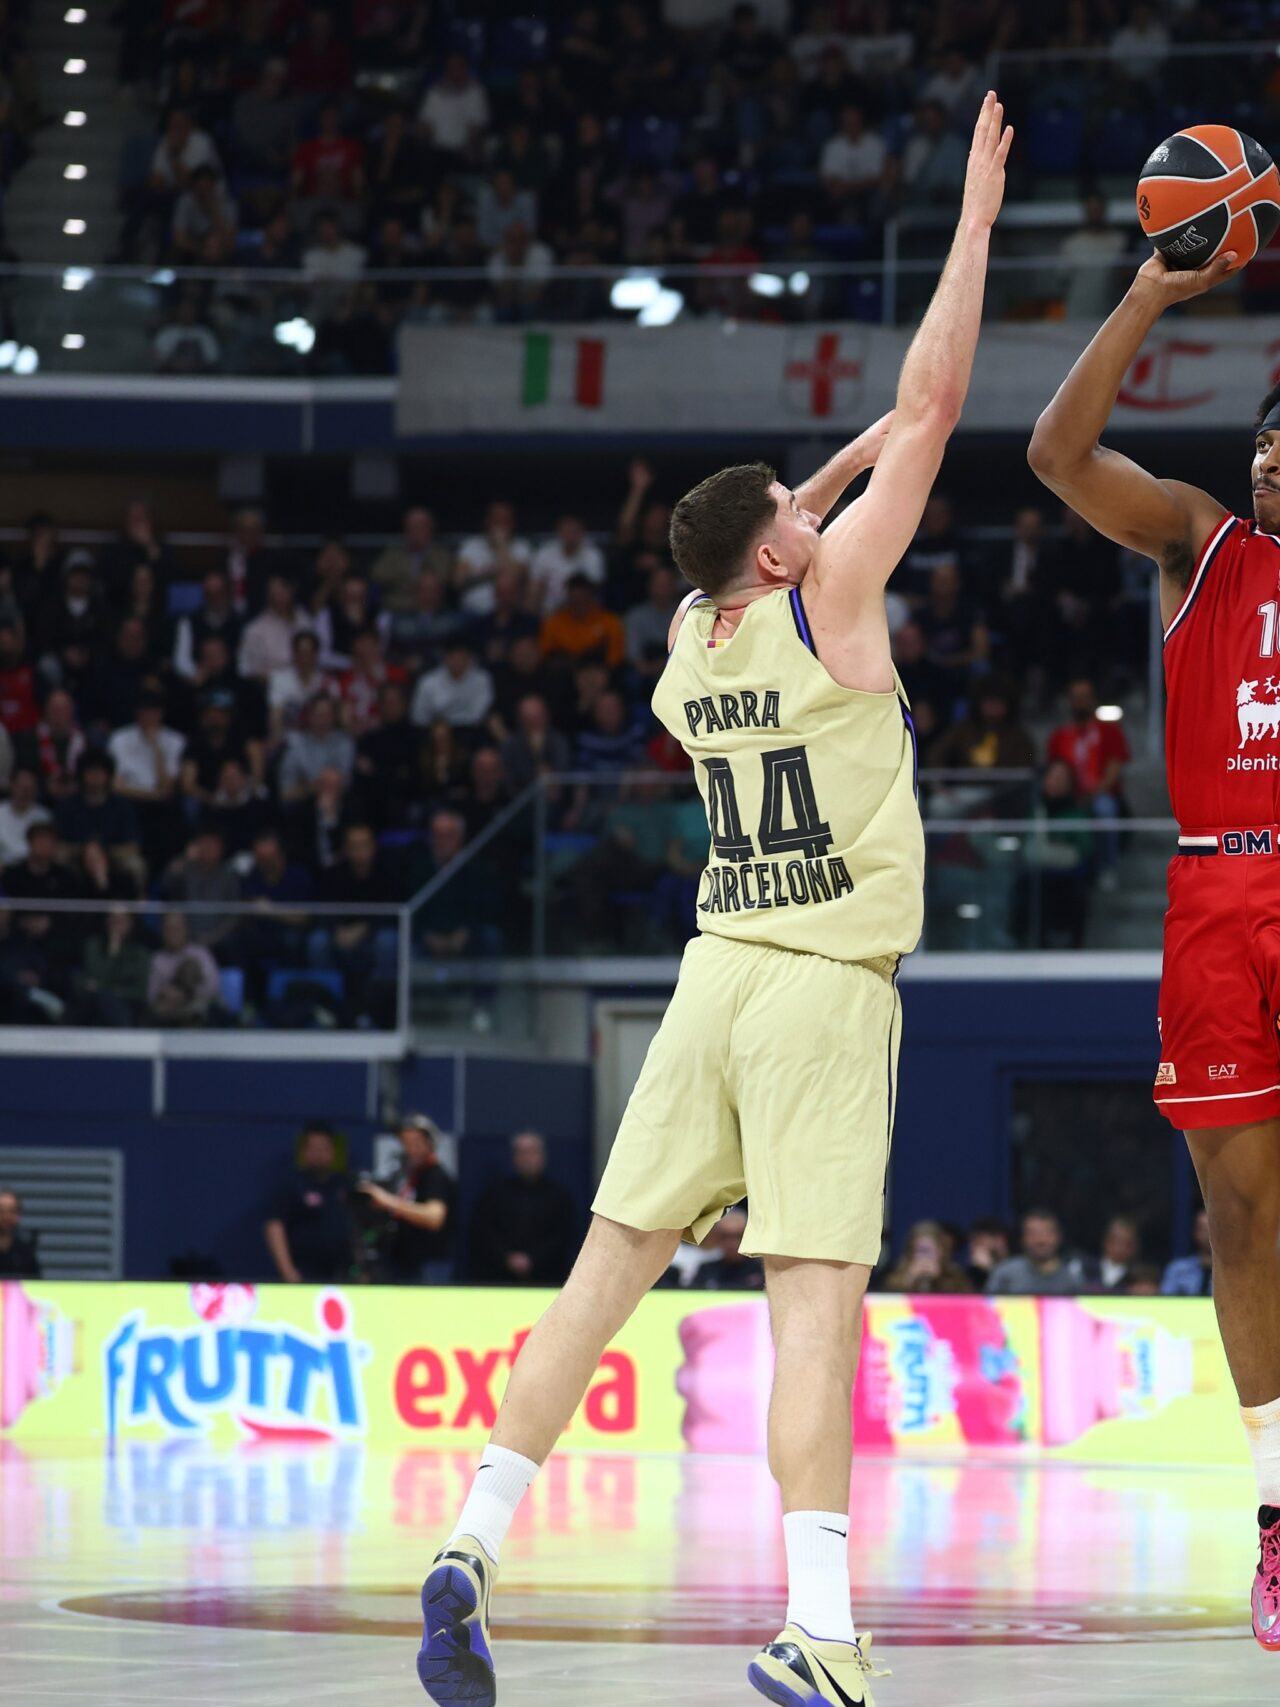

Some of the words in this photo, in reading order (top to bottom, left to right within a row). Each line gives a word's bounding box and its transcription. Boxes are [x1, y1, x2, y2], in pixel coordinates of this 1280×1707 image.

[683, 690, 781, 738] PARRA
[1222, 830, 1273, 856] OM
[1208, 1063, 1237, 1077] EA7
[394, 1328, 636, 1433] exa
